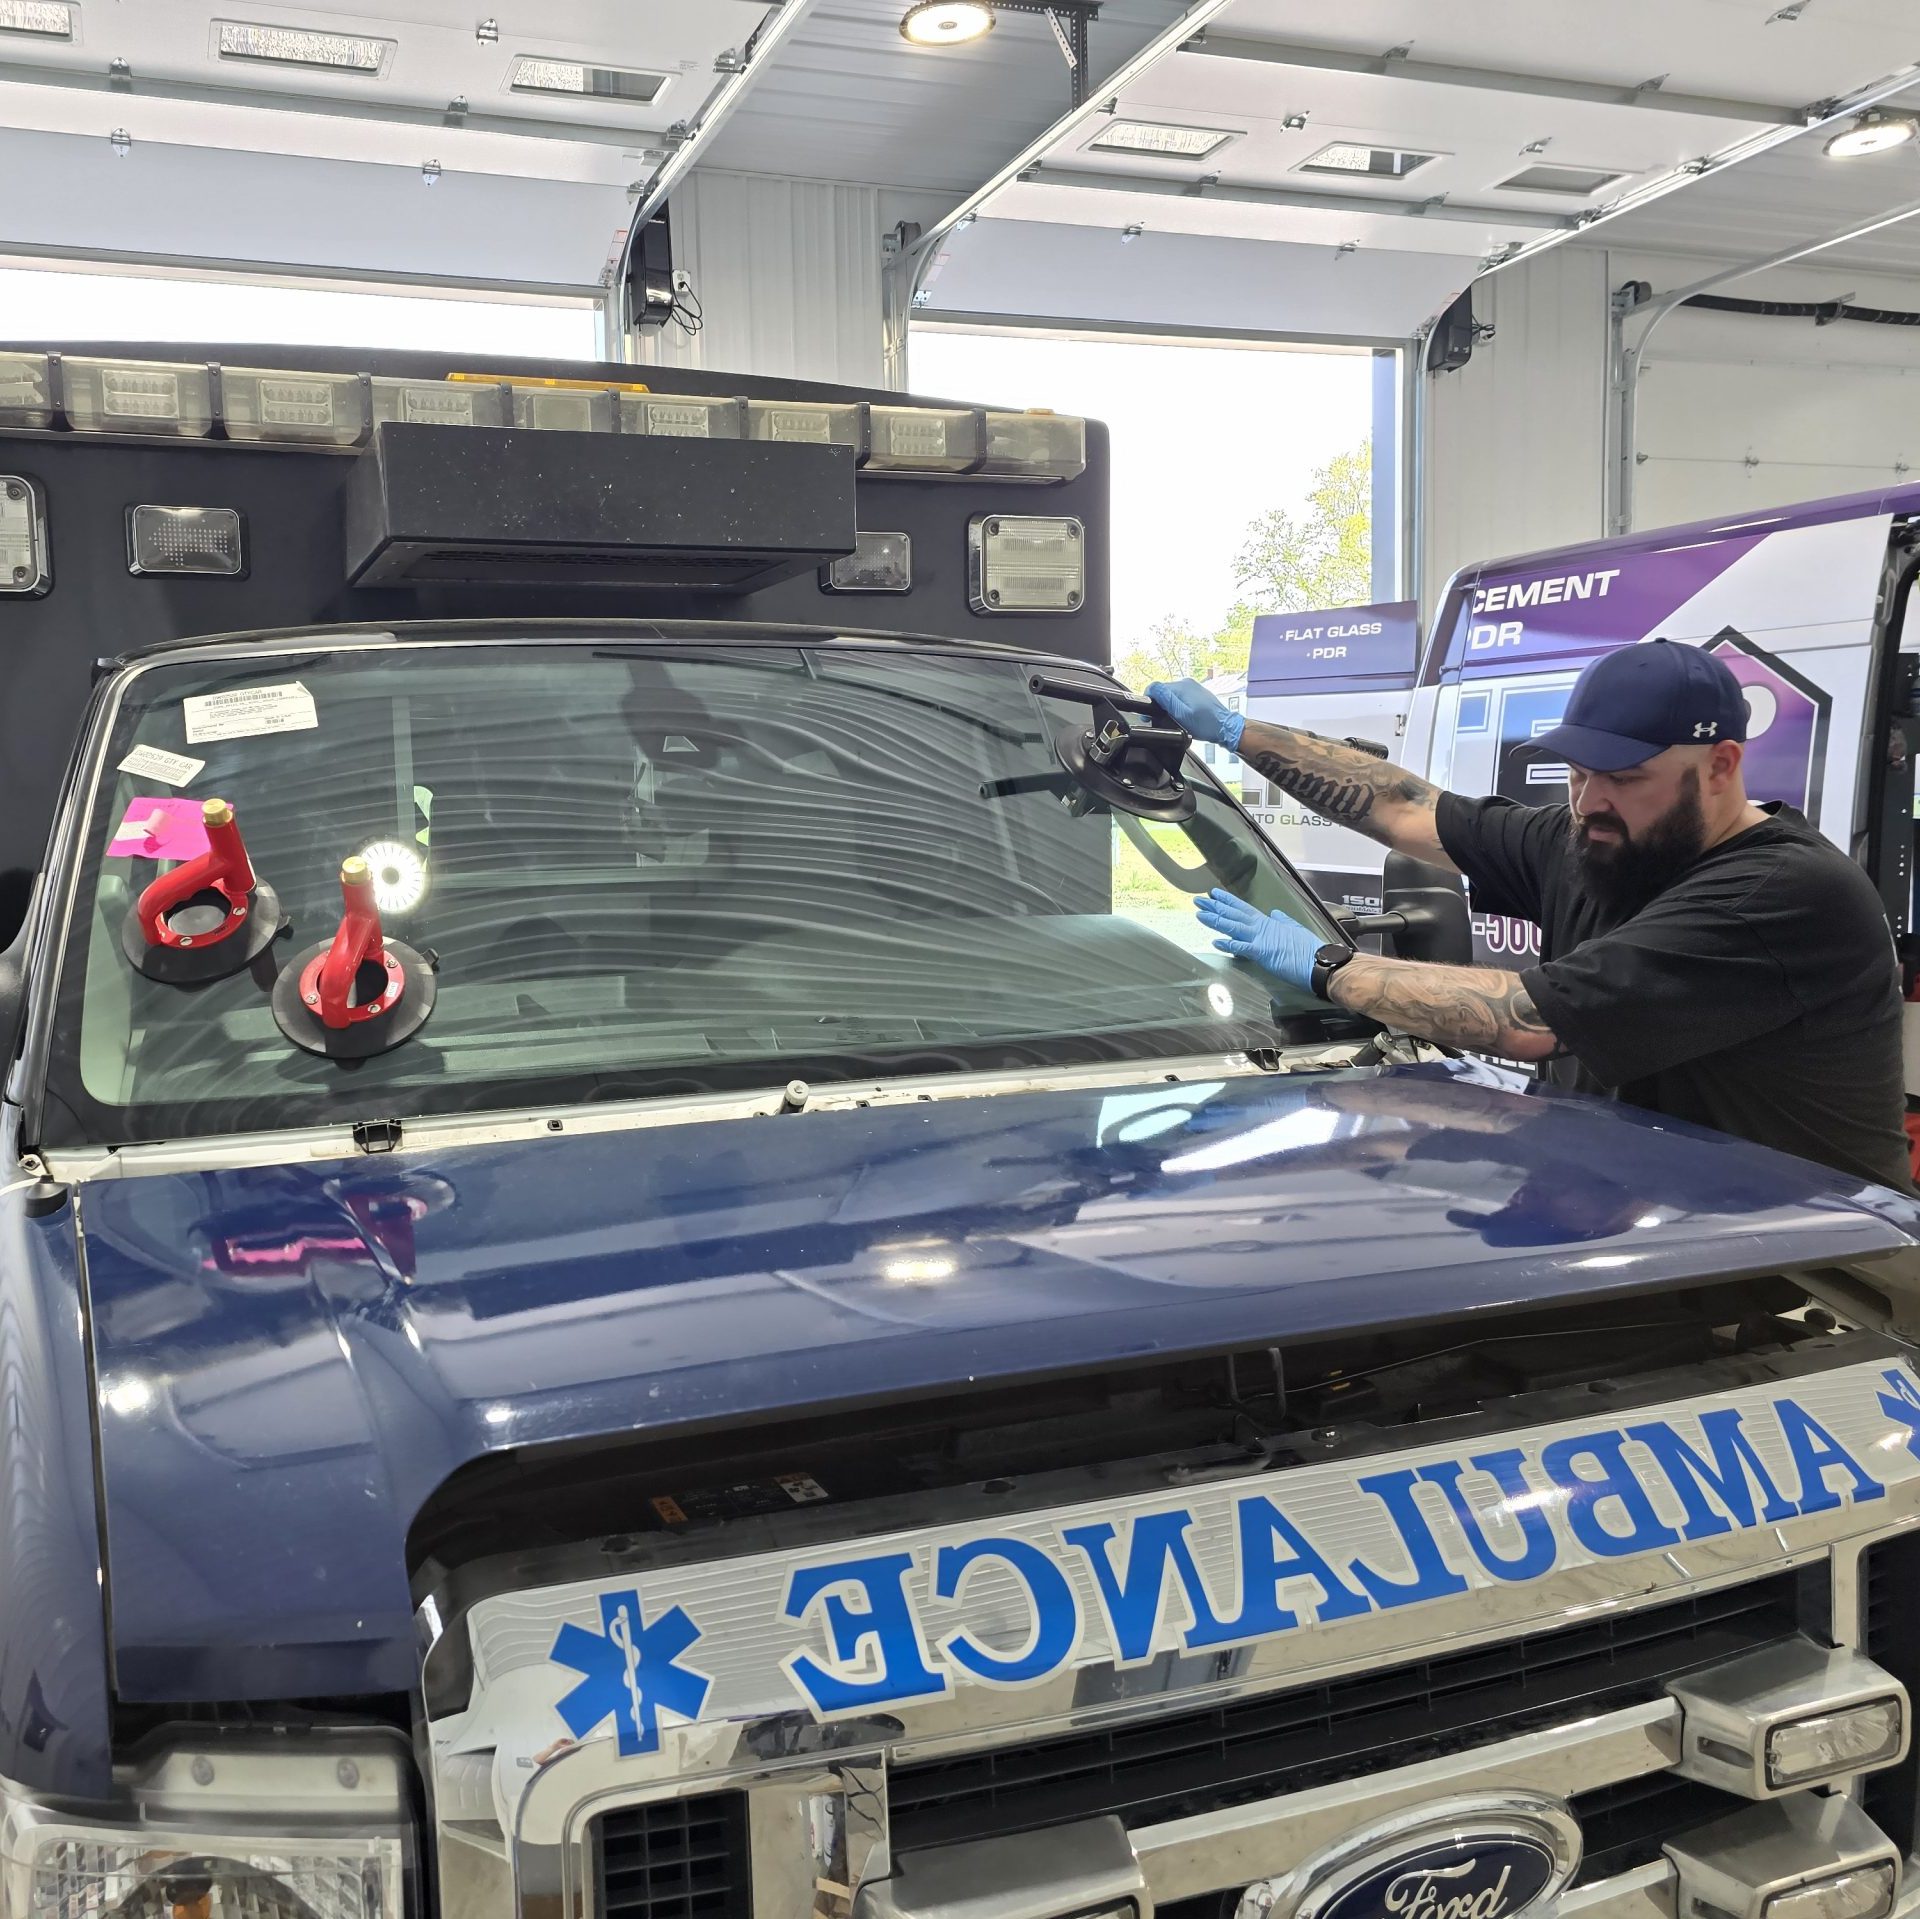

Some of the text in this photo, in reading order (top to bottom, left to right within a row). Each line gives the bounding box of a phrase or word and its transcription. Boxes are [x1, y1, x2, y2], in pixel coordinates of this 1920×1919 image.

[1285, 622, 1383, 641] FLAT GLASS
[1467, 620, 1524, 650] DR
[1312, 646, 1348, 660] PDR
[1280, 814, 1333, 827] GLASS
[1383, 1857, 1512, 1919] Ford
